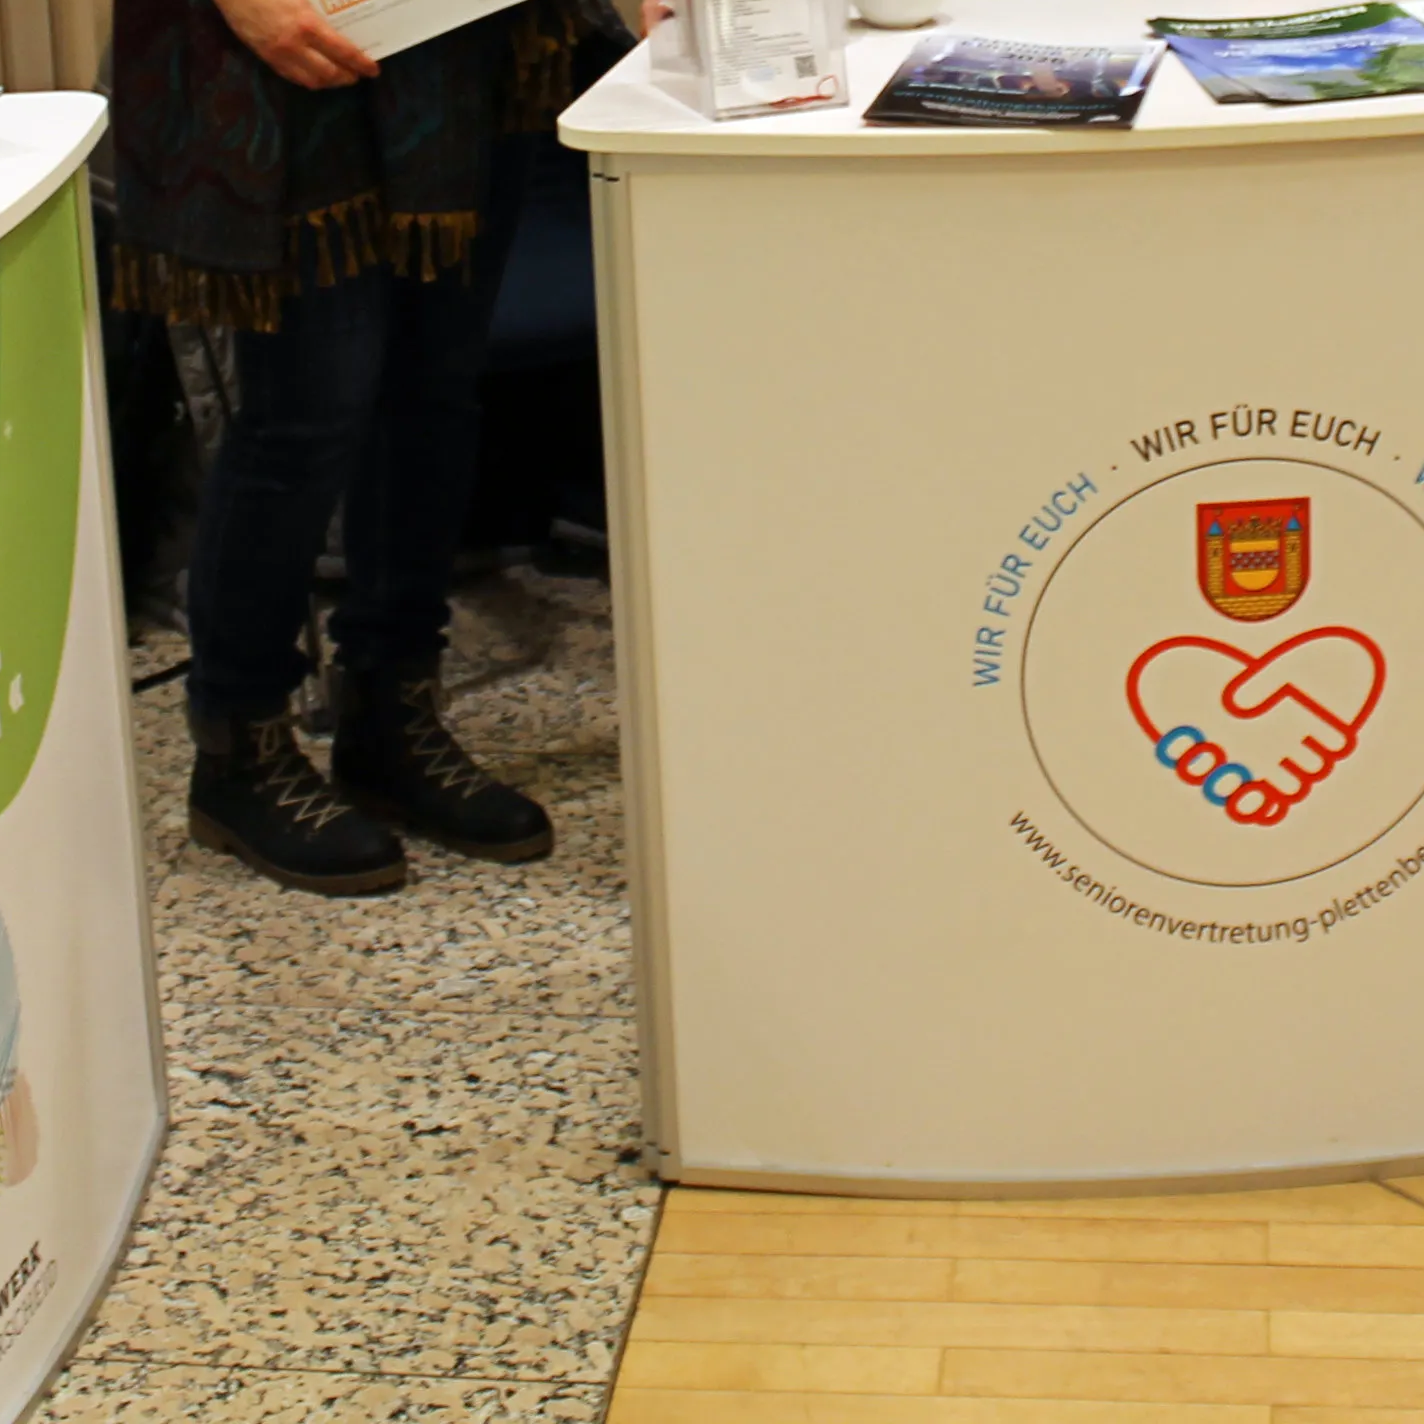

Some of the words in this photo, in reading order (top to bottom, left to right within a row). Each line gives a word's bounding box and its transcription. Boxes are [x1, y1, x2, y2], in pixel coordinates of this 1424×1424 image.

[1130, 420, 1200, 463] WIR
[1210, 404, 1278, 440] FÜR
[1289, 409, 1382, 456] EUCH
[1017, 472, 1099, 552] EUCH
[983, 553, 1034, 617] FÜR
[972, 626, 1007, 688] WIR
